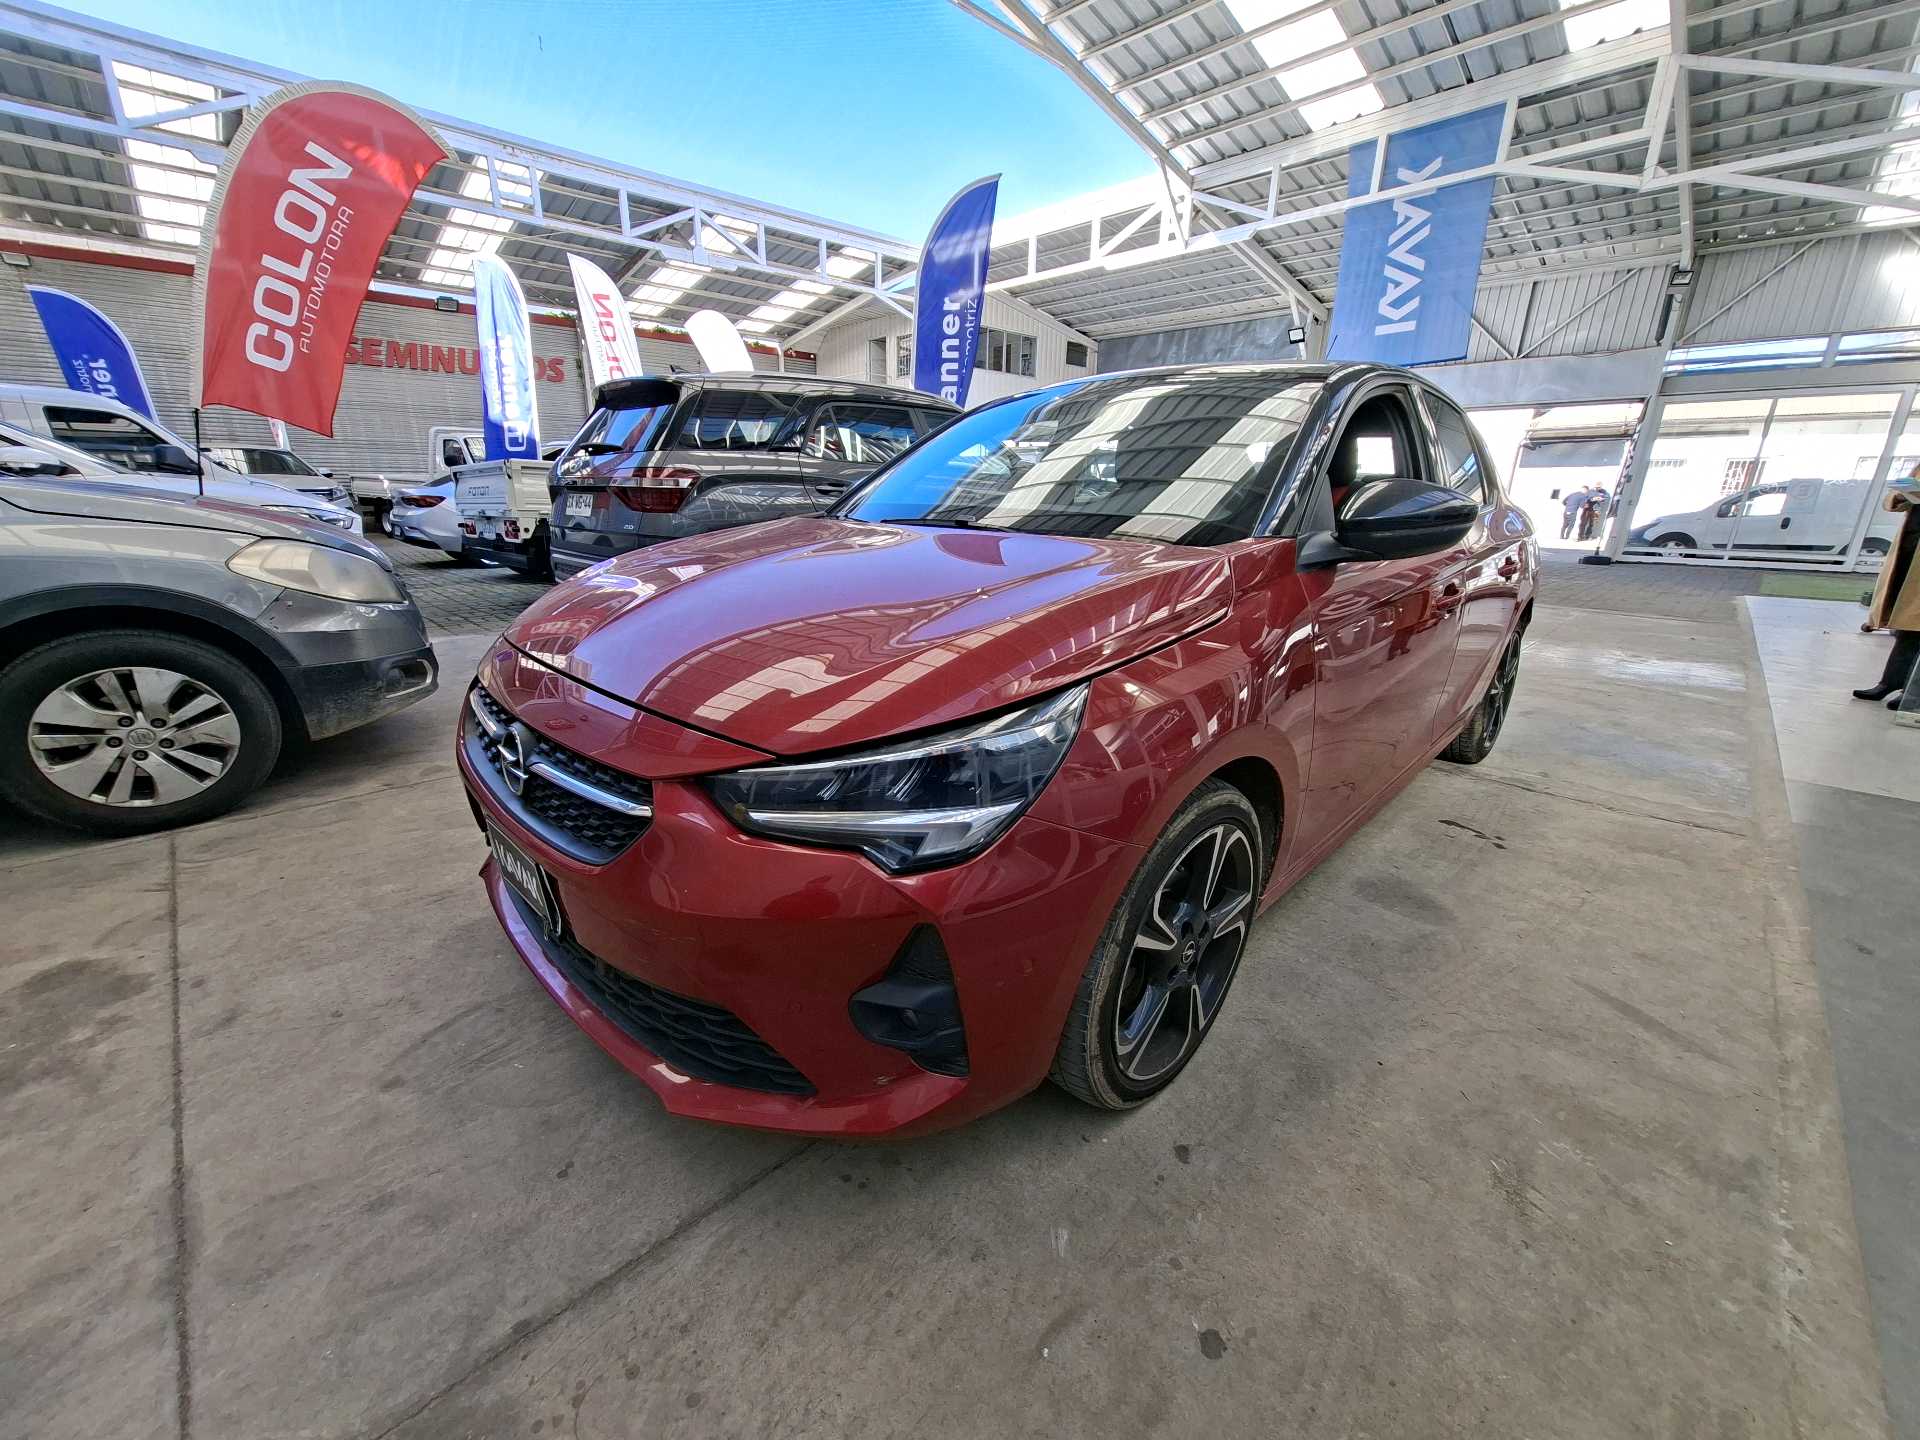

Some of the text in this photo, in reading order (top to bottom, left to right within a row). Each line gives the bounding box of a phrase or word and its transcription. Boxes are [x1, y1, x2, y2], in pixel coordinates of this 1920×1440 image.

[245, 141, 353, 372] COLON
[300, 206, 354, 353] AUTOMOTORA
[1375, 156, 1443, 335] KAVAK
[344, 337, 565, 383] SEMINUOS
[940, 296, 960, 402] anner
